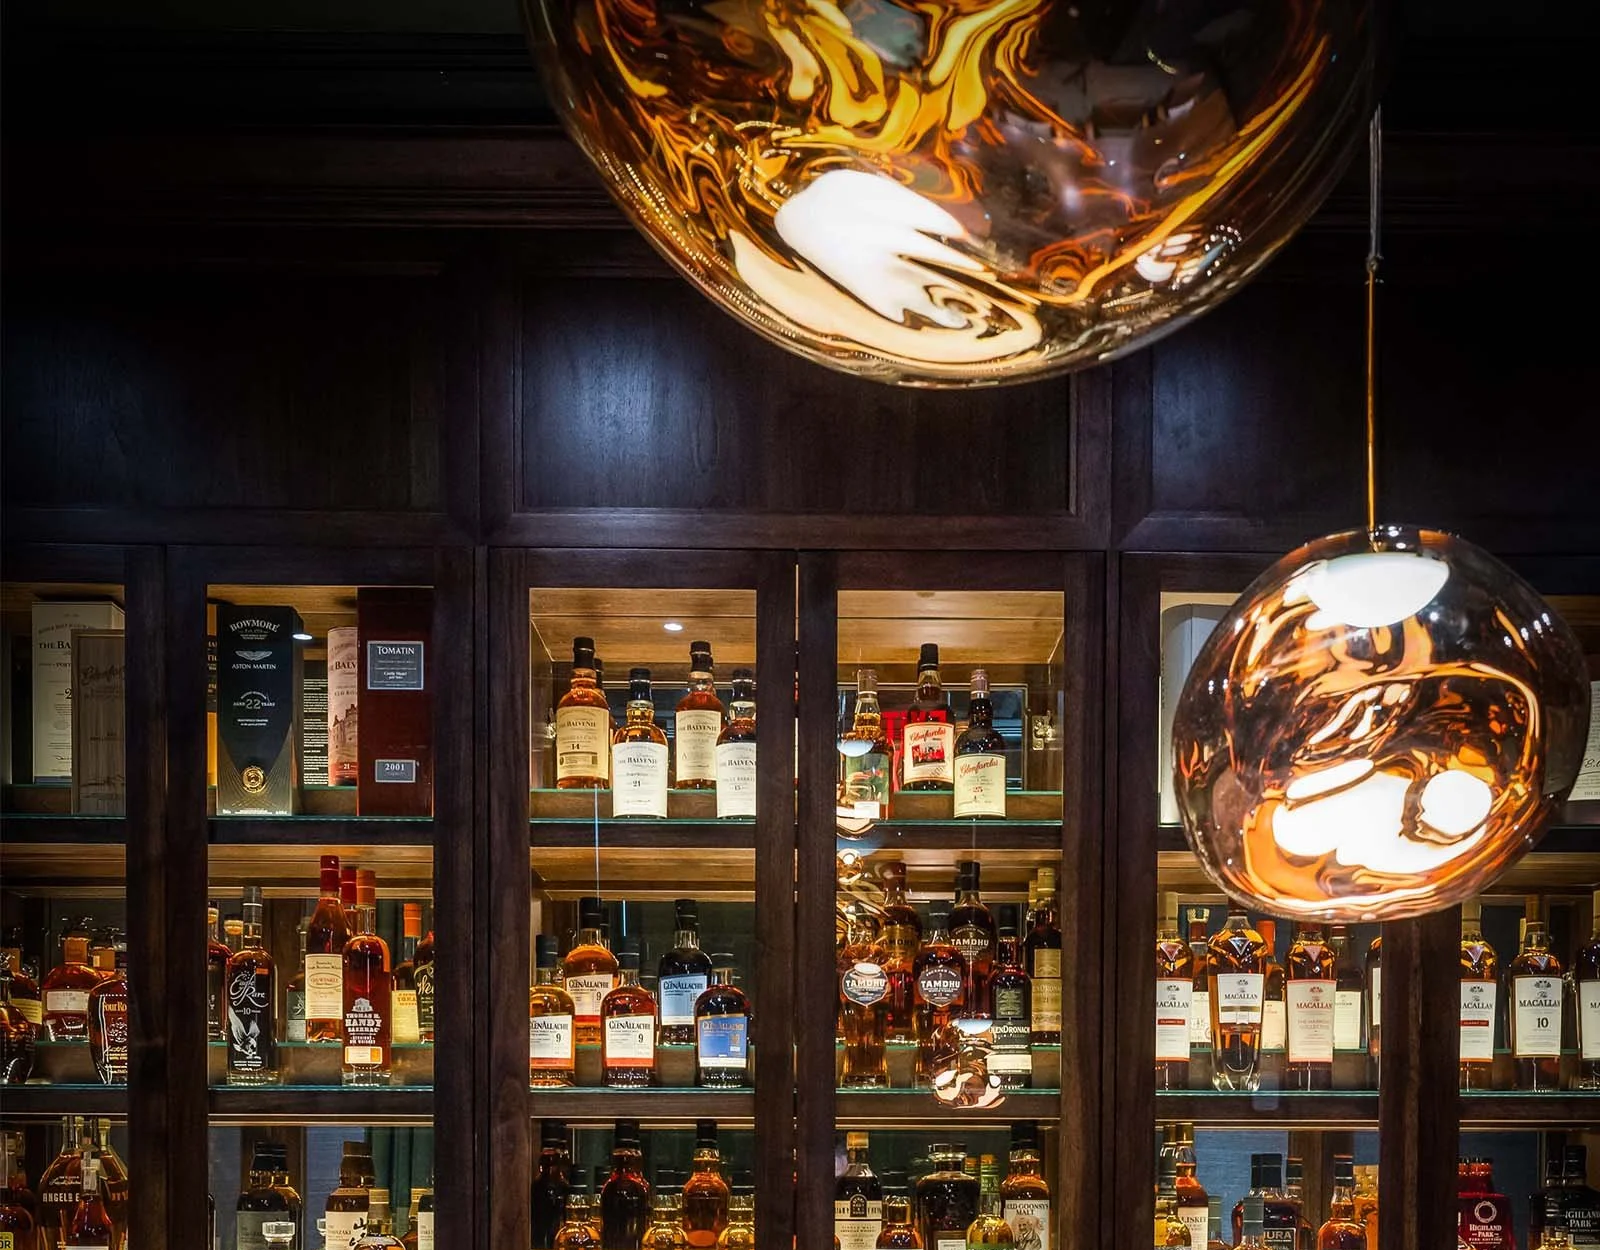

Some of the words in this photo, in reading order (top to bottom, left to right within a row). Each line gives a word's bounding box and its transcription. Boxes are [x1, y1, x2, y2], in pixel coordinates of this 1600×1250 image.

[229, 619, 280, 633] BOWMORE
[57, 641, 71, 649] BA
[377, 645, 415, 655] TOMATIN
[335, 661, 356, 670] BALV
[245, 698, 261, 710] 22
[909, 728, 947, 745] Glenfarclas
[384, 763, 405, 771] 2001
[959, 759, 999, 777] Glenfarclas
[950, 938, 989, 946] TAMDHU
[845, 979, 885, 988] TAMDHU
[920, 980, 960, 988] TAMDHU
[596, 992, 602, 1001] 9
[1537, 990, 1548, 999] The
[1296, 1002, 1333, 1010] MACALLAN
[1519, 999, 1560, 1008] MACALLAN
[1590, 1001, 1600, 1009] MA
[242, 1007, 251, 1015] 10
[345, 1019, 382, 1027] HANDY
[1537, 1018, 1548, 1028] 10
[555, 1033, 562, 1042] 9
[638, 1033, 644, 1043] 9
[1569, 1219, 1592, 1228] PARK
